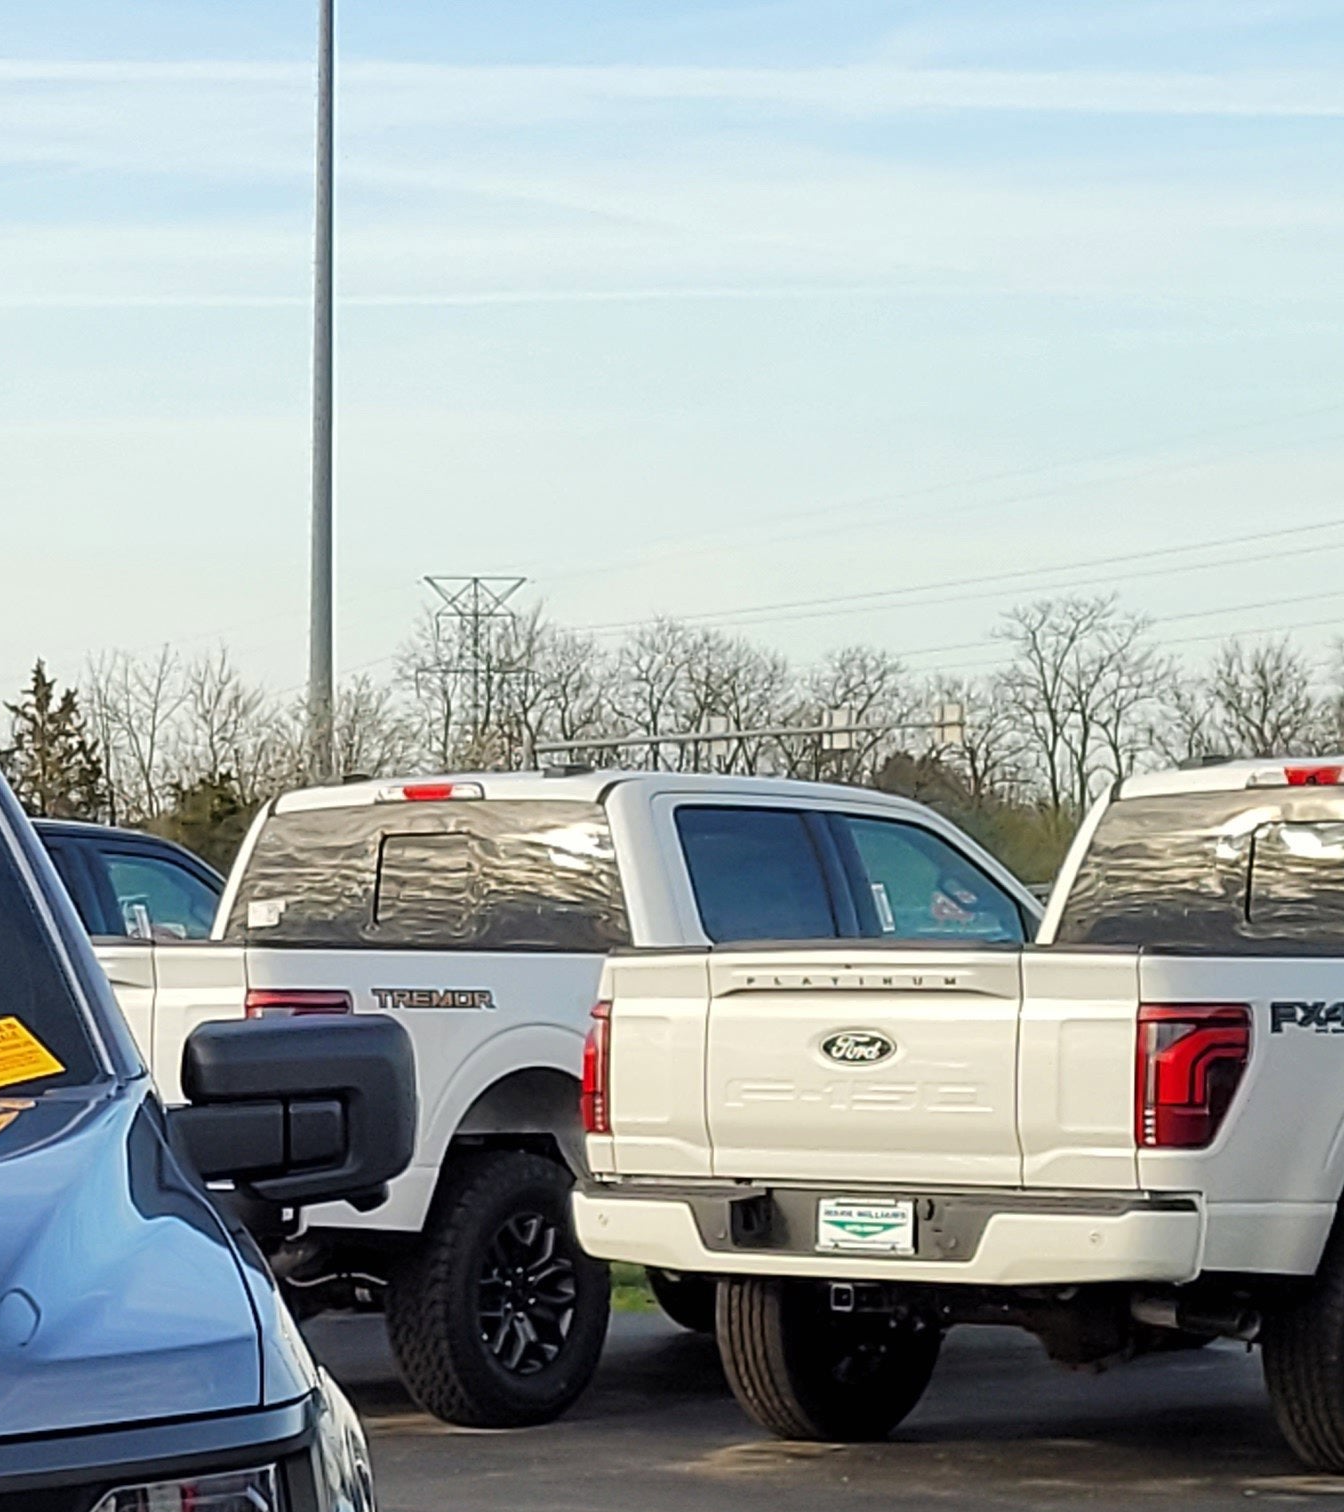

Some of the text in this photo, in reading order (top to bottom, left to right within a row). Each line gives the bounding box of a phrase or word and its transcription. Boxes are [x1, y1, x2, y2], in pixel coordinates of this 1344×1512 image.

[746, 976, 957, 986] PLATINUM
[371, 988, 496, 1009] TREMOR
[831, 1033, 882, 1060] Ford
